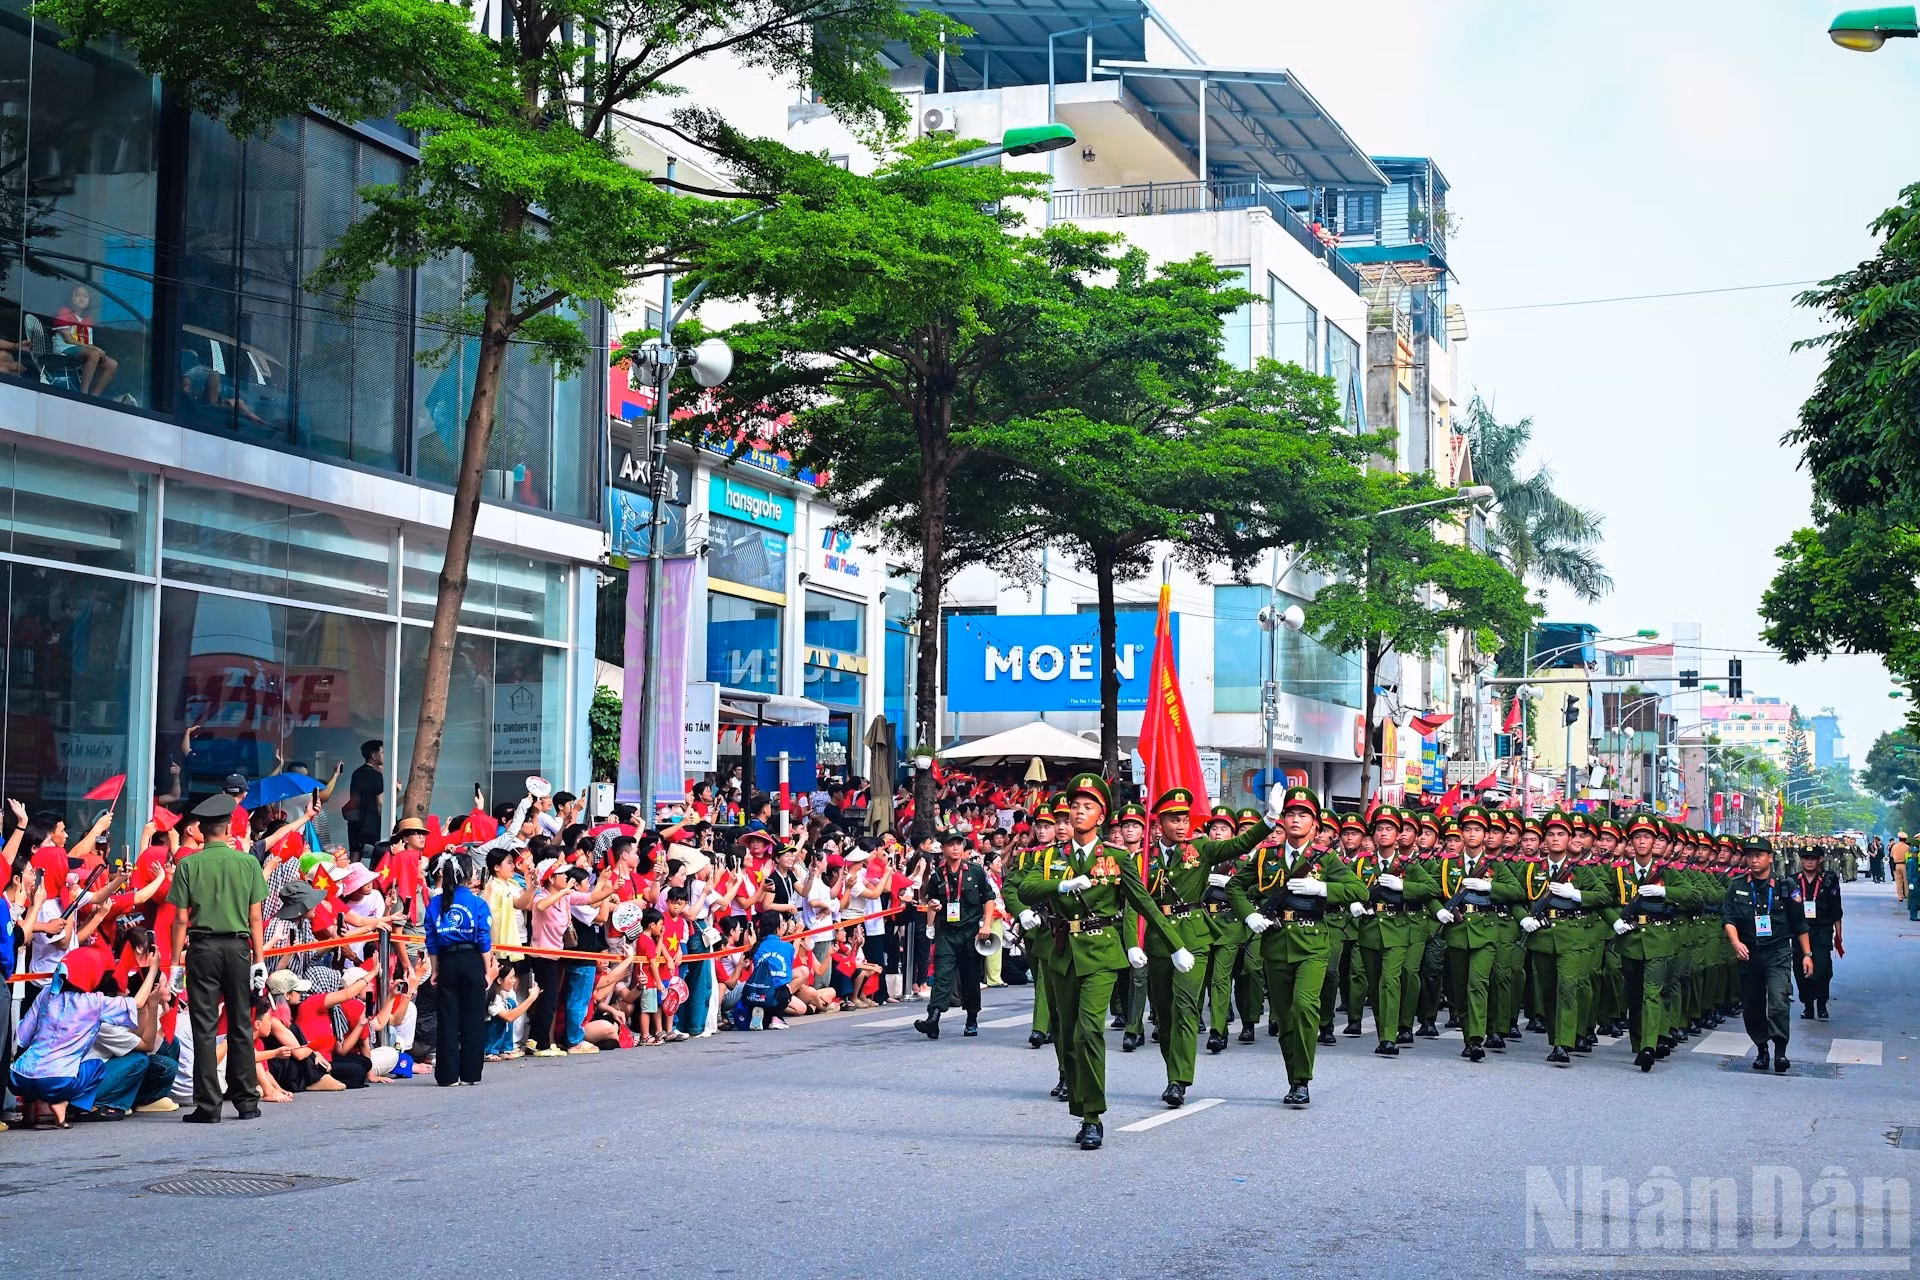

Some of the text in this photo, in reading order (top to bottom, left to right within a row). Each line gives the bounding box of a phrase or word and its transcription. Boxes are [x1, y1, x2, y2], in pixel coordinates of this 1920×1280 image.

[726, 478, 782, 521] hansgrohe
[824, 554, 860, 577] SINO Plastic
